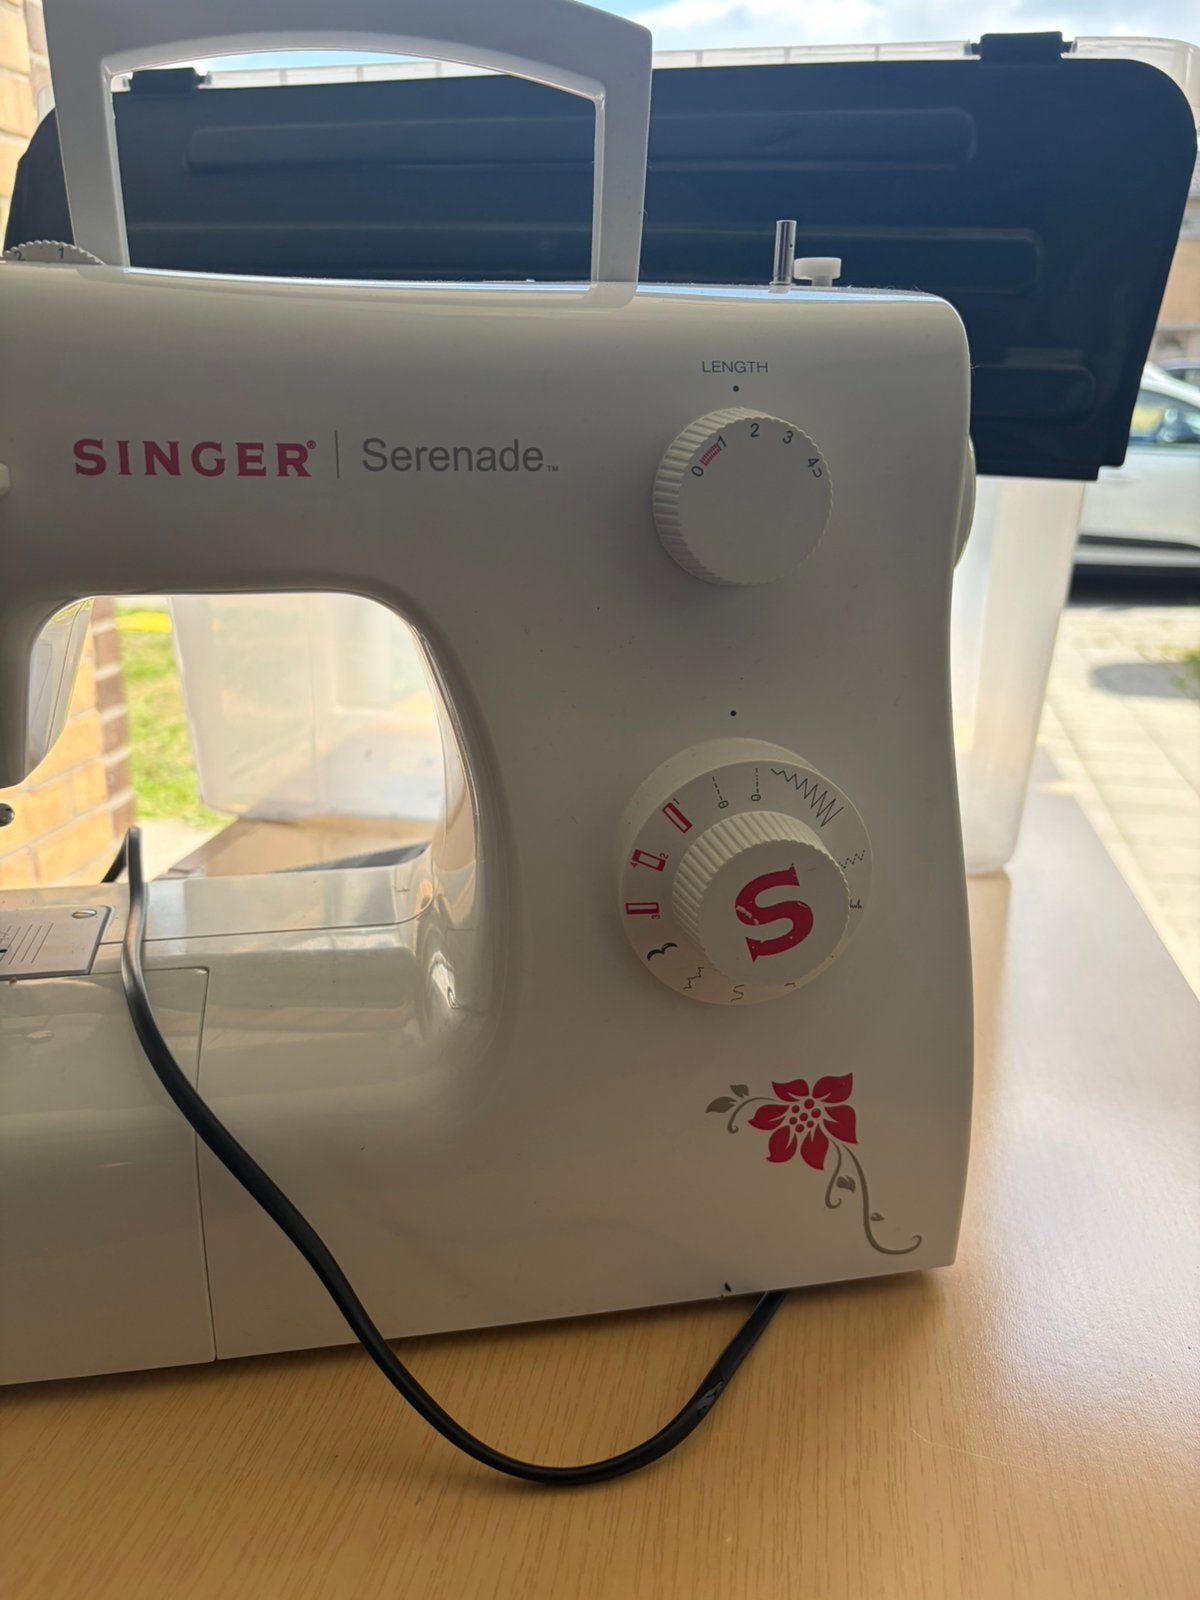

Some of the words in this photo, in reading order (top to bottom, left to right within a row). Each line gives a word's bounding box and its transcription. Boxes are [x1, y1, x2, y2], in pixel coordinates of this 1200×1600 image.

[58, 246, 65, 260] 1
[702, 360, 769, 374] LENGTH
[691, 465, 705, 477] 0
[717, 435, 728, 449] 1
[749, 423, 760, 438] 2
[782, 430, 794, 445] 3
[807, 457, 820, 468] 4
[735, 863, 815, 963] S
